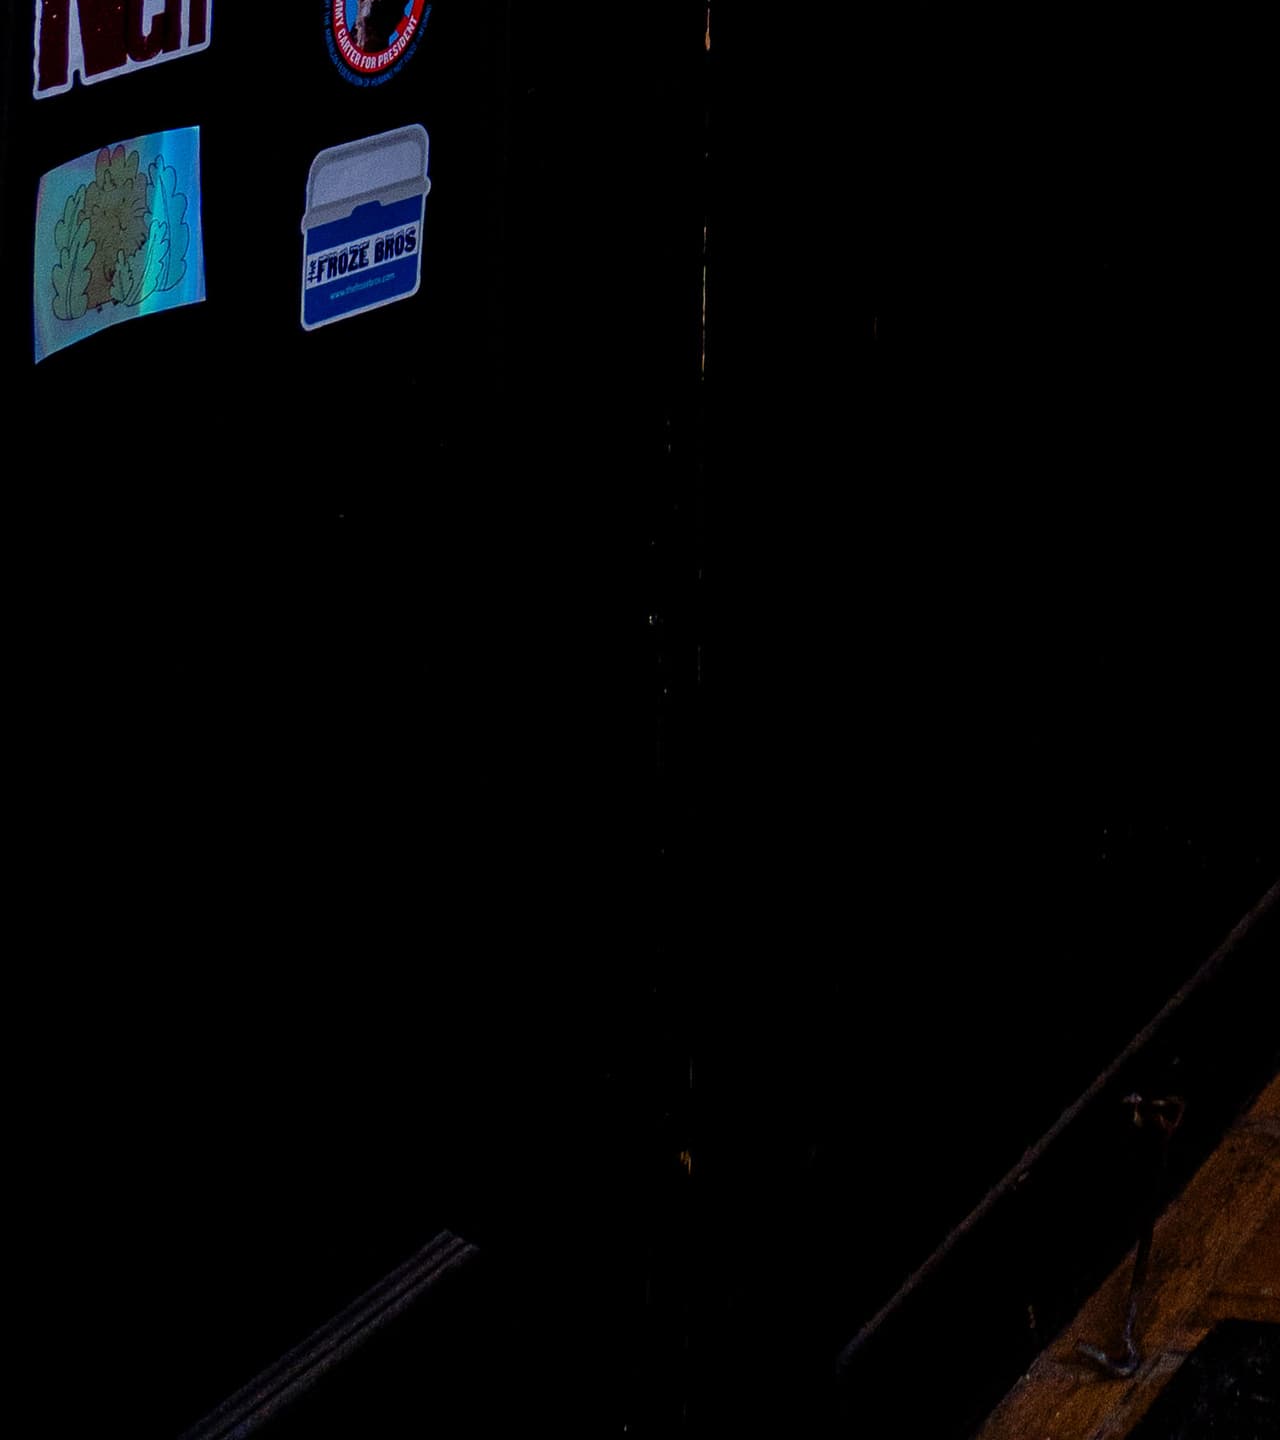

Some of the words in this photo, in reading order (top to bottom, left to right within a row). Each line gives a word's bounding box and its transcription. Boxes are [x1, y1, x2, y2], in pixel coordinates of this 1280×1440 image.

[337, 27, 361, 65] CARTER
[360, 55, 377, 70] FOR
[377, 15, 418, 68] PRESIDENT
[316, 244, 371, 282] FROZE
[374, 227, 417, 262] BROS
